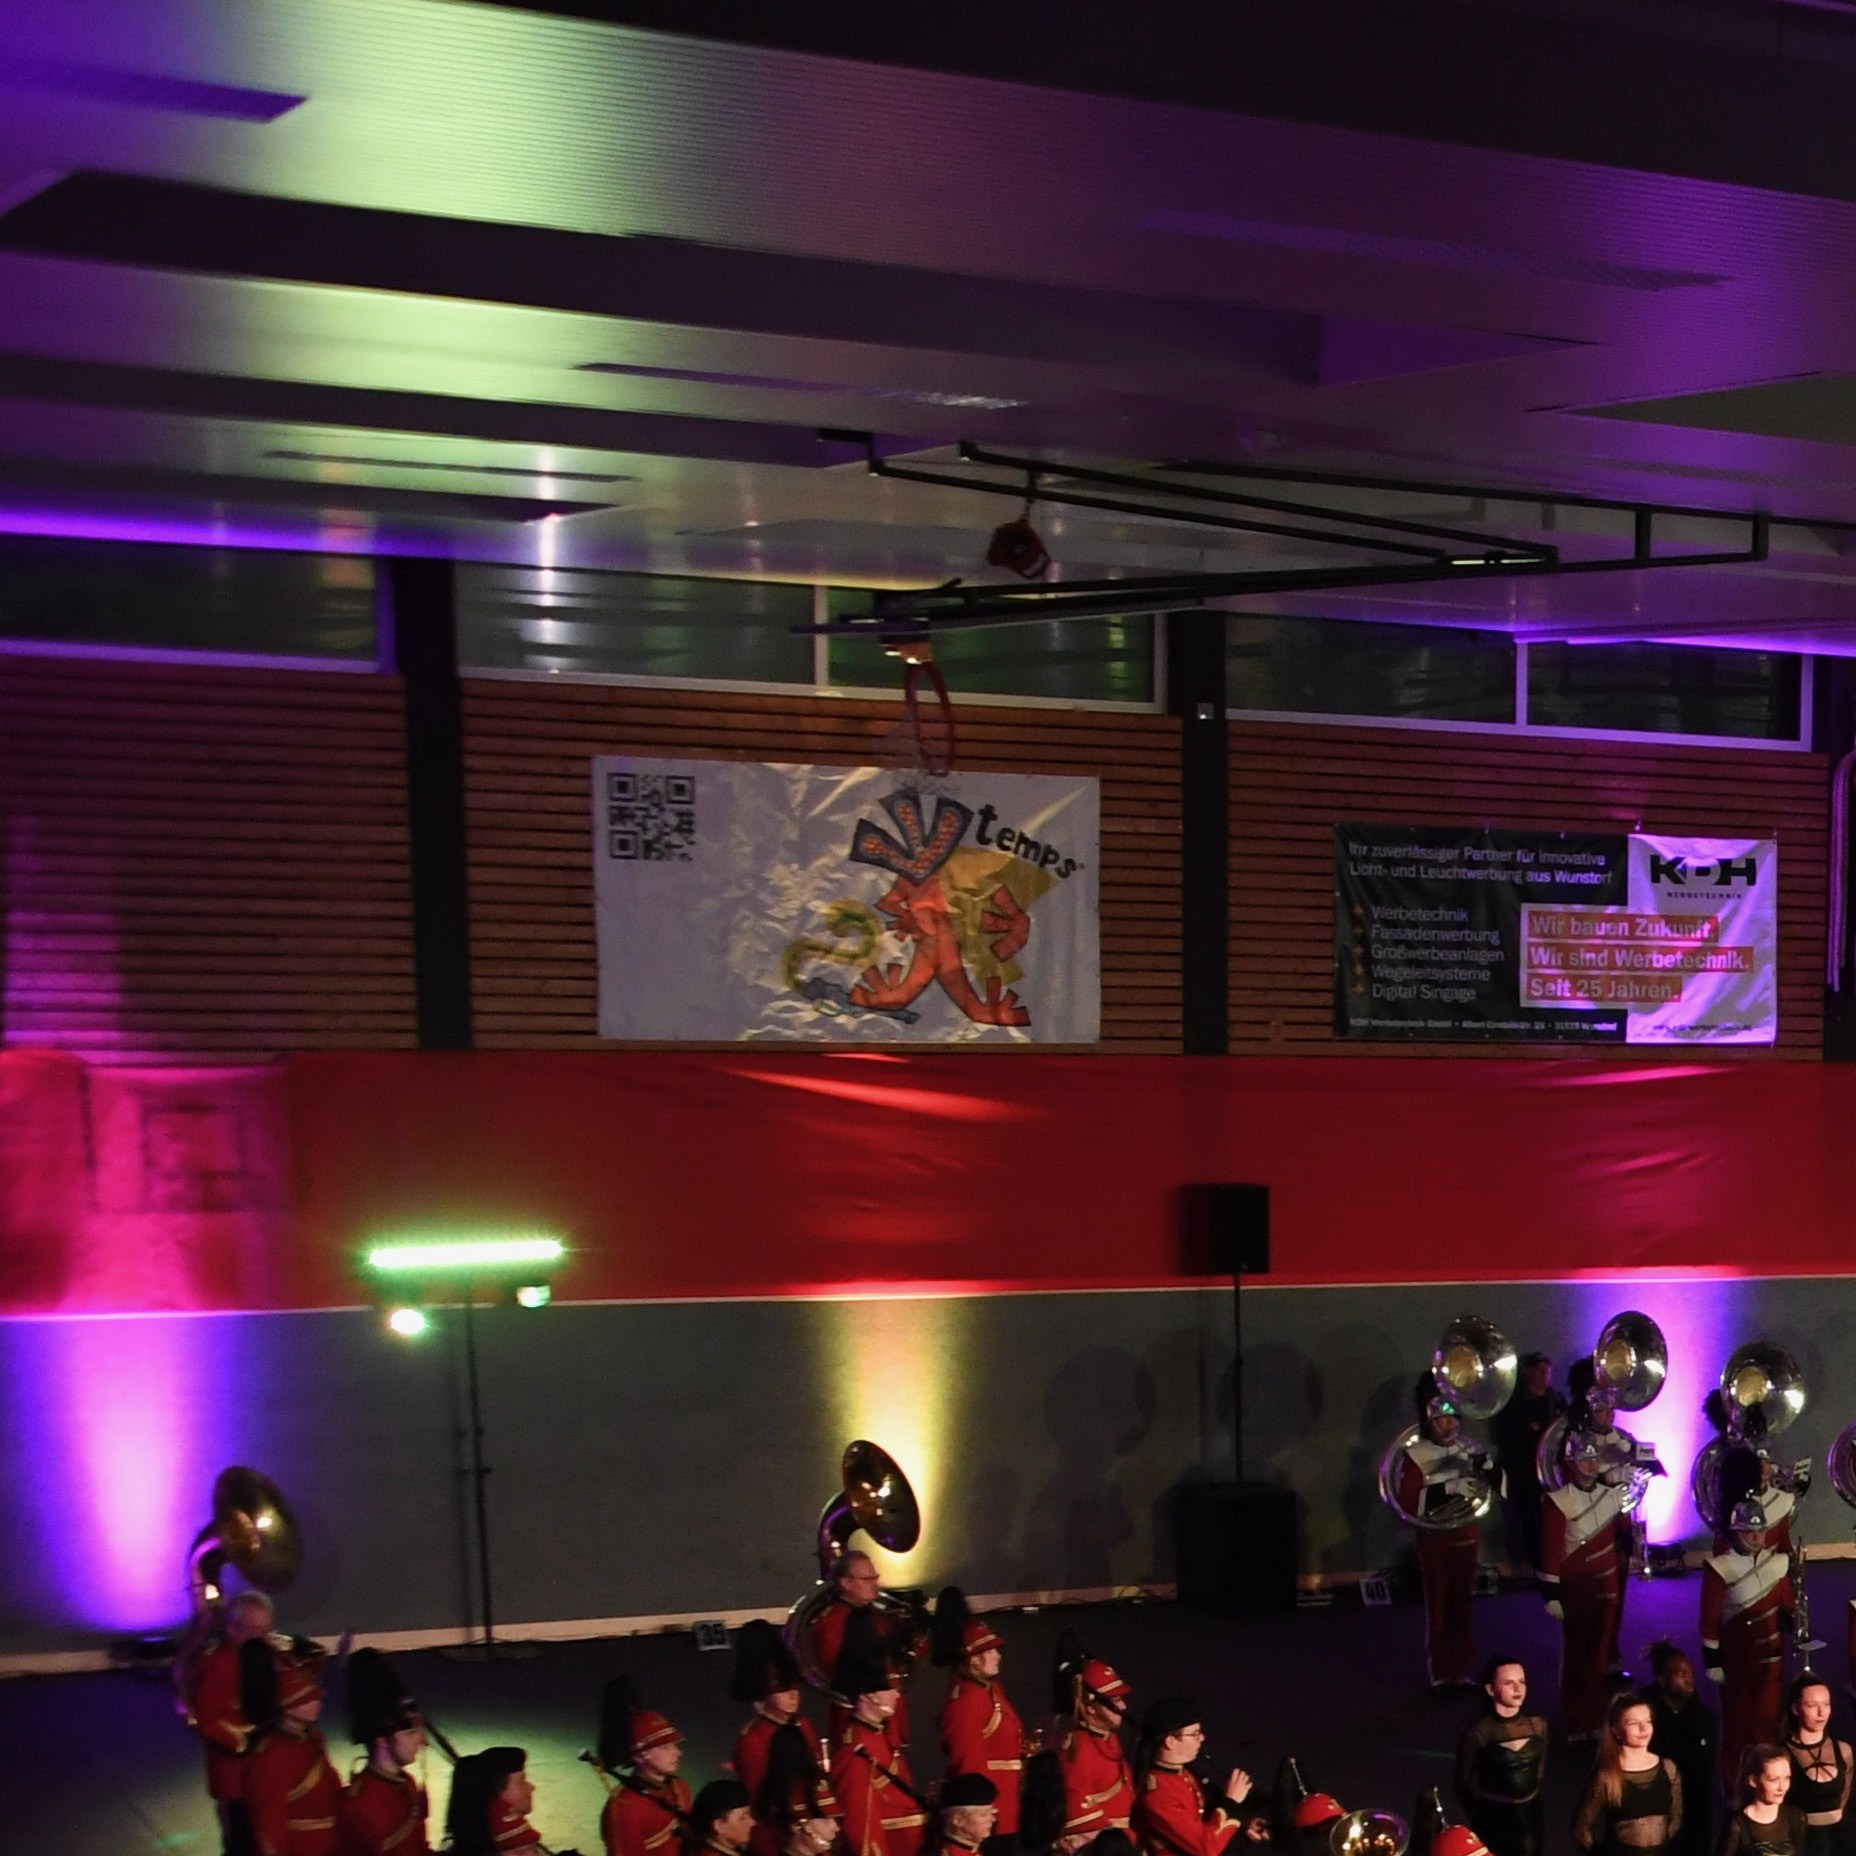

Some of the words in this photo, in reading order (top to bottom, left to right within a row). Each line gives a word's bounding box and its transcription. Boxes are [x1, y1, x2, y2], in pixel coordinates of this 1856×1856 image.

[1464, 846, 1513, 862] Partner
[1532, 915, 1564, 934] Wir
[1570, 917, 1630, 936] bauen
[1530, 947, 1562, 966] Wir
[1569, 949, 1609, 967] sind
[1576, 979, 1604, 998] 25
